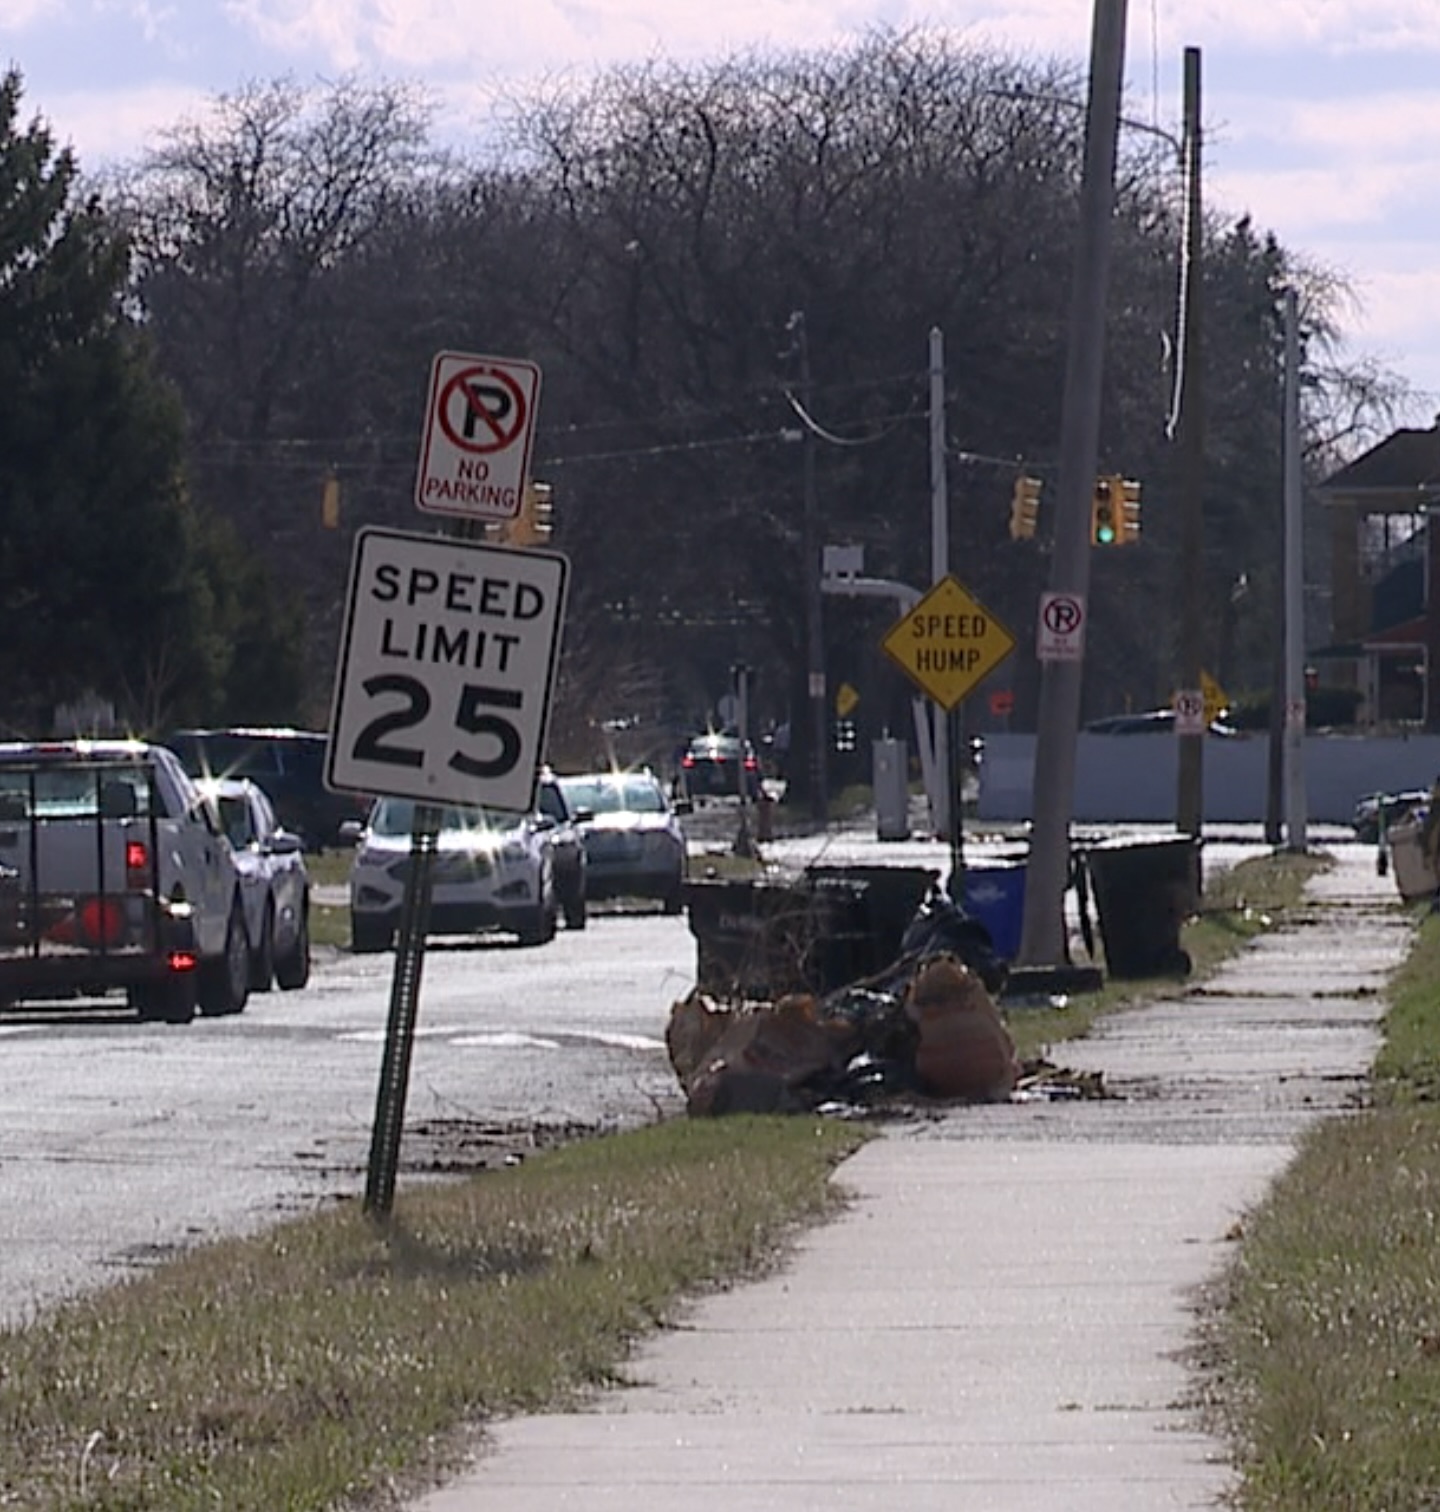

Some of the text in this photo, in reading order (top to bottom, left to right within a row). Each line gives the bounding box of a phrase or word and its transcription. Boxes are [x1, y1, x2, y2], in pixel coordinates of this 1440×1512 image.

[458, 459, 489, 480] NO
[426, 478, 515, 507] PARKING
[371, 564, 544, 620] SPEED
[912, 614, 987, 638] SPEED
[380, 618, 520, 672] LIMIT
[916, 647, 980, 672] HUMP
[352, 674, 523, 779] 25
